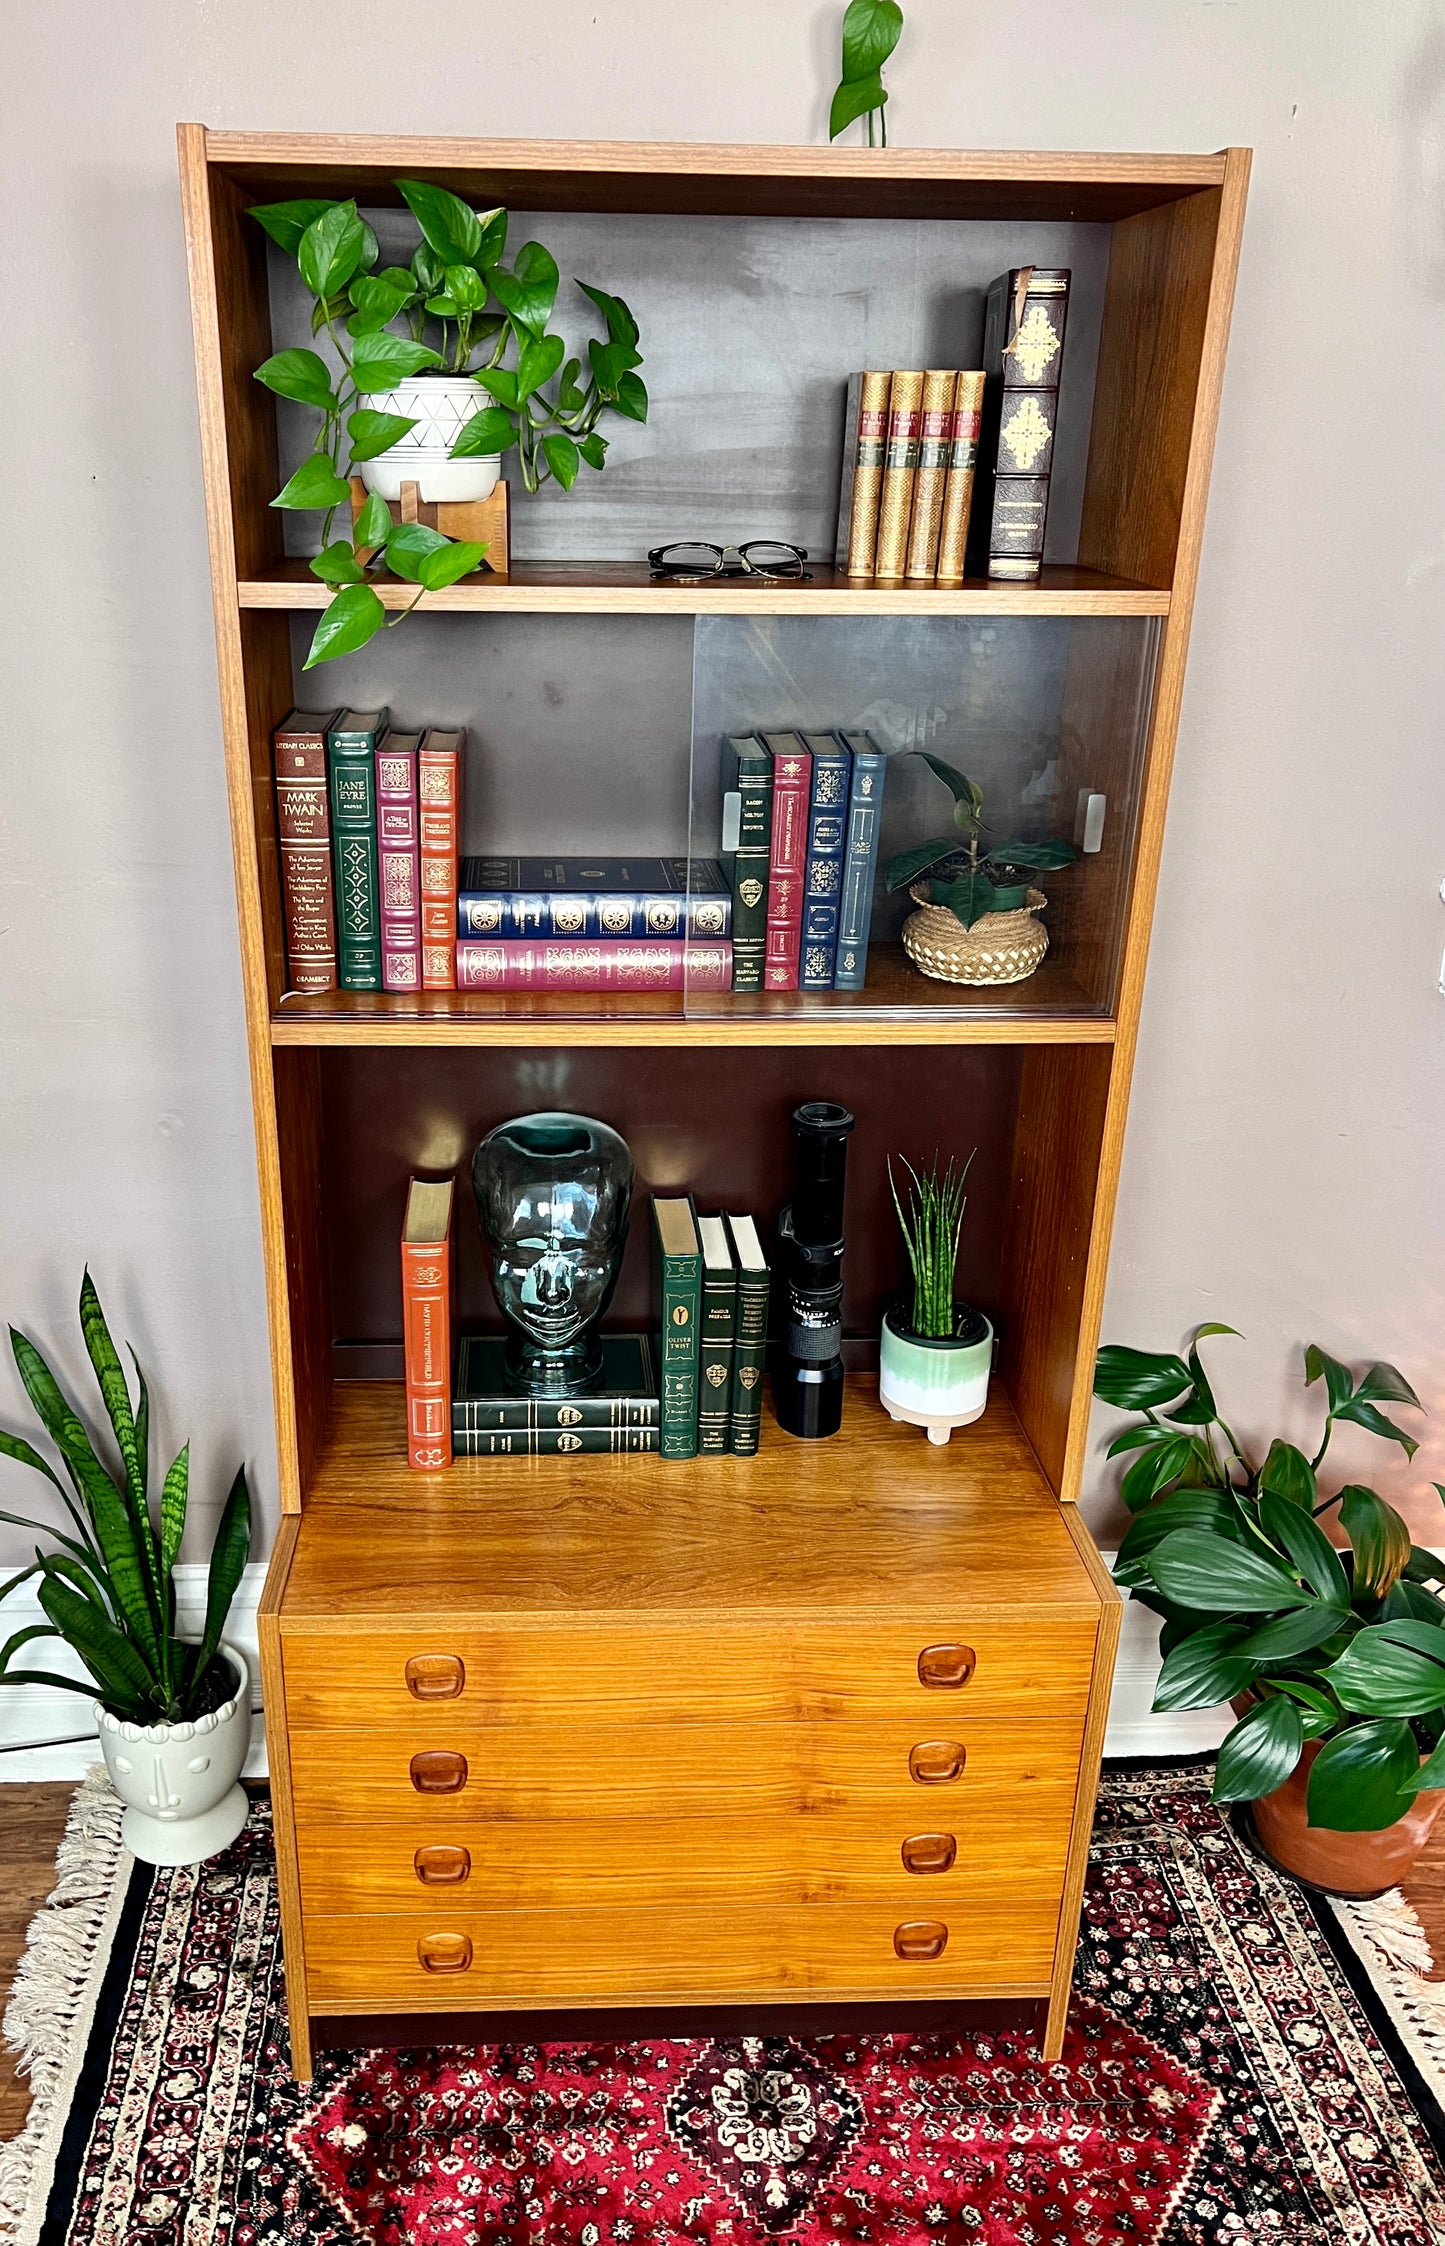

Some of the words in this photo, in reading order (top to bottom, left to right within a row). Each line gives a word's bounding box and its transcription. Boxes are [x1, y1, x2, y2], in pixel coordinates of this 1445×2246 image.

[298, 742, 324, 750] CLASSICS
[338, 780, 366, 791] JANE
[286, 792, 319, 803] MARK
[339, 791, 366, 800] EYRE
[282, 803, 324, 816] TWAIN
[293, 819, 314, 827] Selected
[295, 826, 313, 834] Works
[288, 855, 298, 863] The
[298, 855, 324, 863] Adventures
[306, 864, 323, 872] Sawyer
[296, 875, 322, 883] Adventures
[292, 896, 301, 904] The
[315, 896, 324, 904] and
[300, 943, 315, 951] Other
[425, 1404, 433, 1432] Dickens
